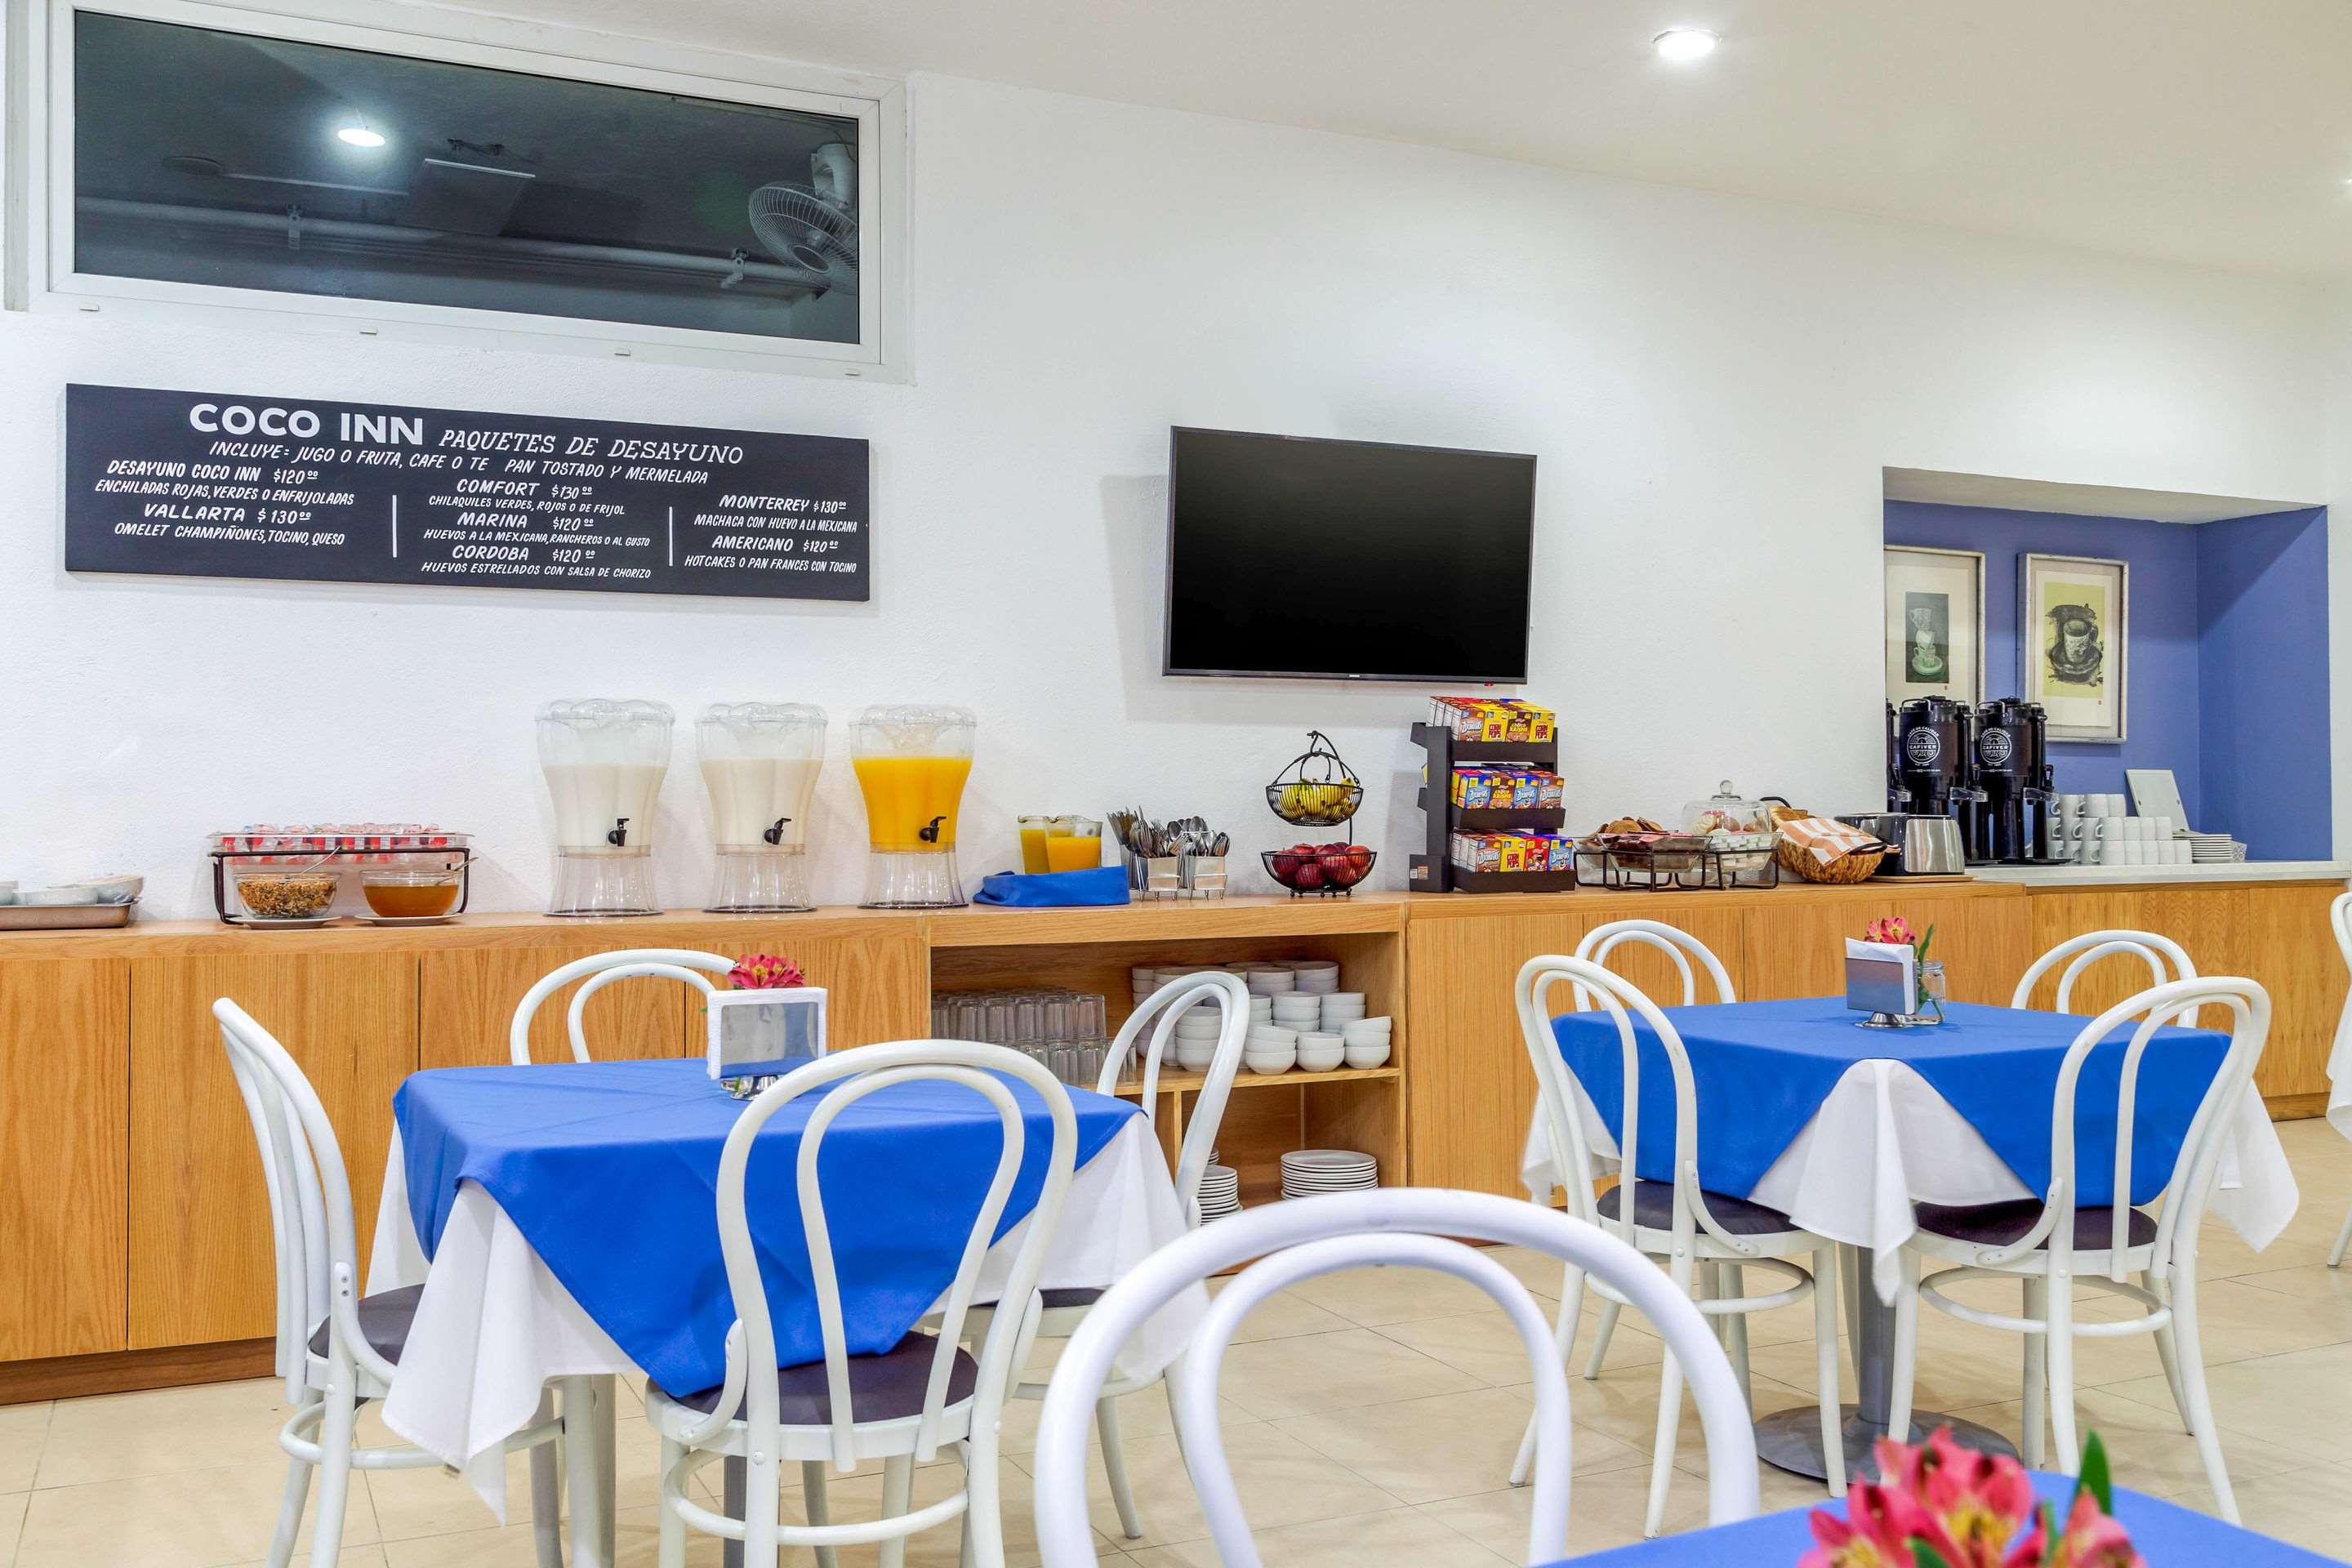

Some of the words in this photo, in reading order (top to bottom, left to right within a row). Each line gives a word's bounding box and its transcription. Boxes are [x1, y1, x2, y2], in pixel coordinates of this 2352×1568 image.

[189, 403, 321, 439] COCO
[341, 412, 423, 445] INN
[438, 429, 556, 453] PAQUETES
[564, 436, 599, 457] DE
[607, 439, 743, 465] DESAYUNO
[106, 460, 186, 478] DESAYUNO
[191, 463, 230, 480] COCO
[234, 466, 261, 482] INN
[209, 441, 290, 459] INCLUYE:
[290, 446, 336, 464] JUGO
[340, 449, 352, 463] O
[409, 453, 448, 469] CAFE
[451, 456, 463, 470] O
[470, 457, 490, 471] TE
[504, 458, 537, 474] PAN
[541, 461, 604, 478] TOSTADO
[609, 465, 622, 479] Y
[625, 466, 708, 484] MERMELADA
[95, 479, 171, 495] ENCHILADAS
[261, 488, 271, 501] O
[271, 489, 355, 506] ENFRIJOLADAS
[457, 479, 541, 497] COMFORT
[144, 503, 246, 522] VALLARTA
[429, 495, 492, 508] CHILAQUILES
[536, 501, 568, 514] ROJOS
[568, 503, 577, 512] O
[578, 503, 592, 513] DE
[593, 504, 625, 518] FRIJOL
[719, 494, 810, 512] MONTERREY
[457, 511, 528, 528] MARINA
[693, 514, 745, 528] MACHACA
[746, 515, 767, 528] CON
[768, 517, 798, 530] HUEVO
[798, 519, 806, 531] A
[806, 519, 817, 531] LA
[817, 519, 858, 533] MEXICANA
[114, 522, 171, 537] OMELET
[311, 532, 345, 546] QUESO
[423, 528, 466, 541] HUEVOS
[468, 531, 477, 541] A
[479, 531, 493, 541] LA
[604, 536, 611, 546] O
[612, 536, 623, 546] AL
[625, 537, 651, 547] GUSTO
[711, 535, 794, 552] AMERICANO
[452, 545, 529, 561] CORDOBA
[421, 561, 468, 573] HUEVOS
[470, 563, 541, 575] ESTRELLADOS
[544, 565, 566, 576] CON
[567, 567, 595, 577] SALSA
[597, 567, 611, 577] DE
[612, 568, 652, 579] CHORIZO
[684, 555, 736, 568] HOTCAKES
[738, 557, 746, 568] O
[747, 557, 769, 569] PAN
[769, 558, 809, 571] FRANCES
[810, 560, 828, 572] CON
